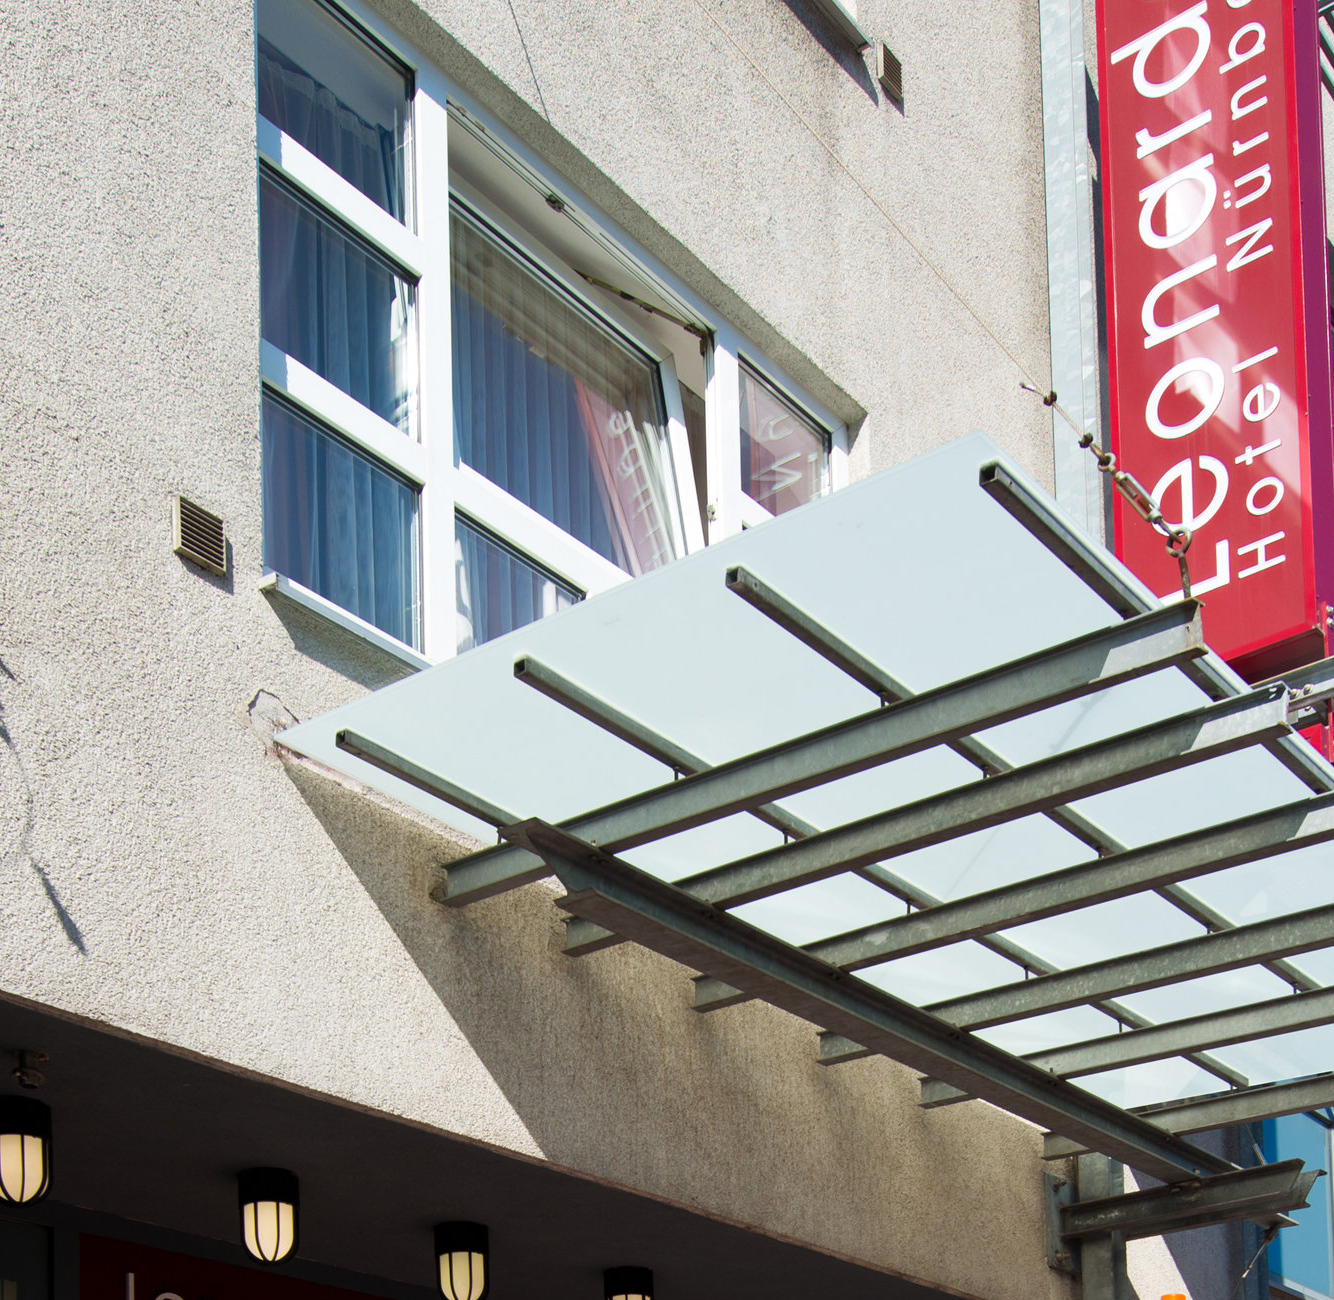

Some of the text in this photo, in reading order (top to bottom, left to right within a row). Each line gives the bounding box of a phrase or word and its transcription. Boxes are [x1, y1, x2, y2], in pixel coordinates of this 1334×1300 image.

[1111, 0, 1231, 607] Leonard
[1219, 0, 1287, 579] Hotel Nürnb
